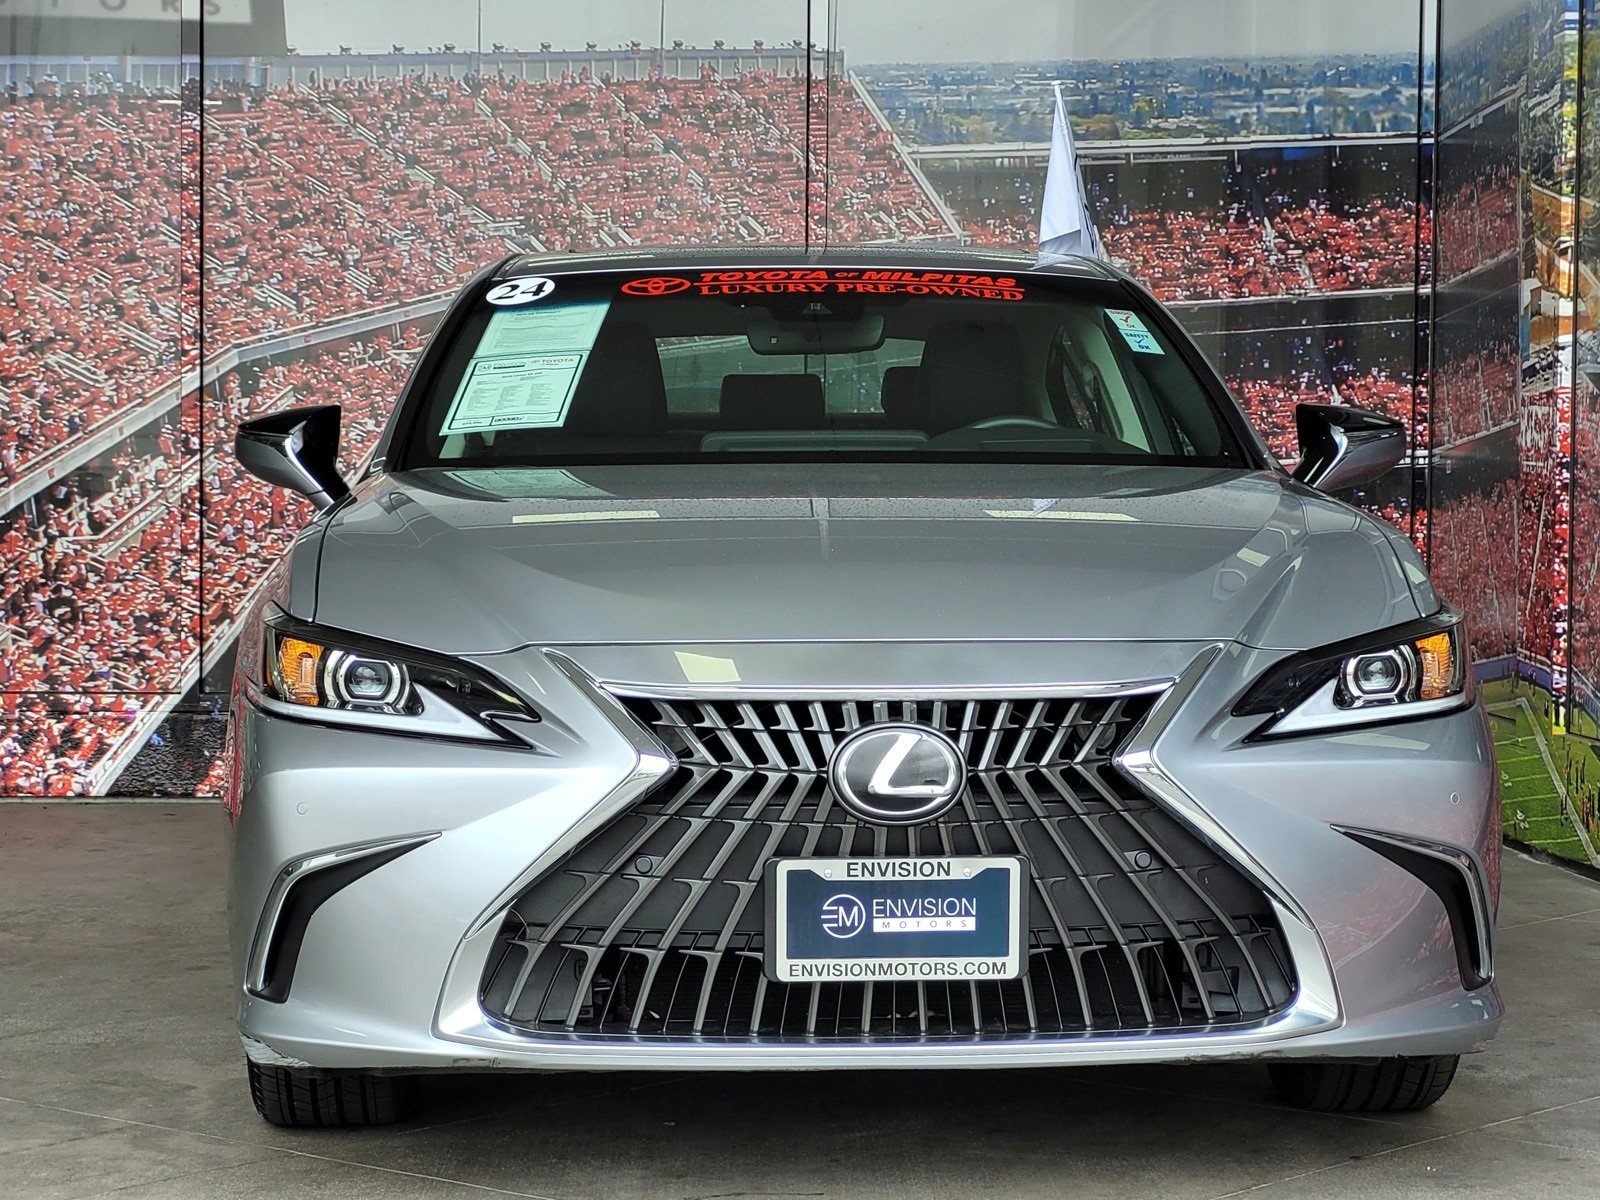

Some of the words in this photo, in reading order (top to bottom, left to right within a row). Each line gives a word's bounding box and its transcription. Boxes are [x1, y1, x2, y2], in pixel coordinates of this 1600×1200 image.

[701, 271, 828, 282] TOYOTA
[861, 271, 1016, 287] MILPITAS
[492, 280, 548, 300] 24
[700, 283, 828, 295] LUXURY
[837, 283, 1024, 301] PRE-OWNED
[846, 861, 951, 878] ENVISION
[872, 898, 976, 917] ENVISION
[882, 920, 967, 930] MOTORS
[789, 961, 1007, 977] ENVISIONMOTORS.COM
